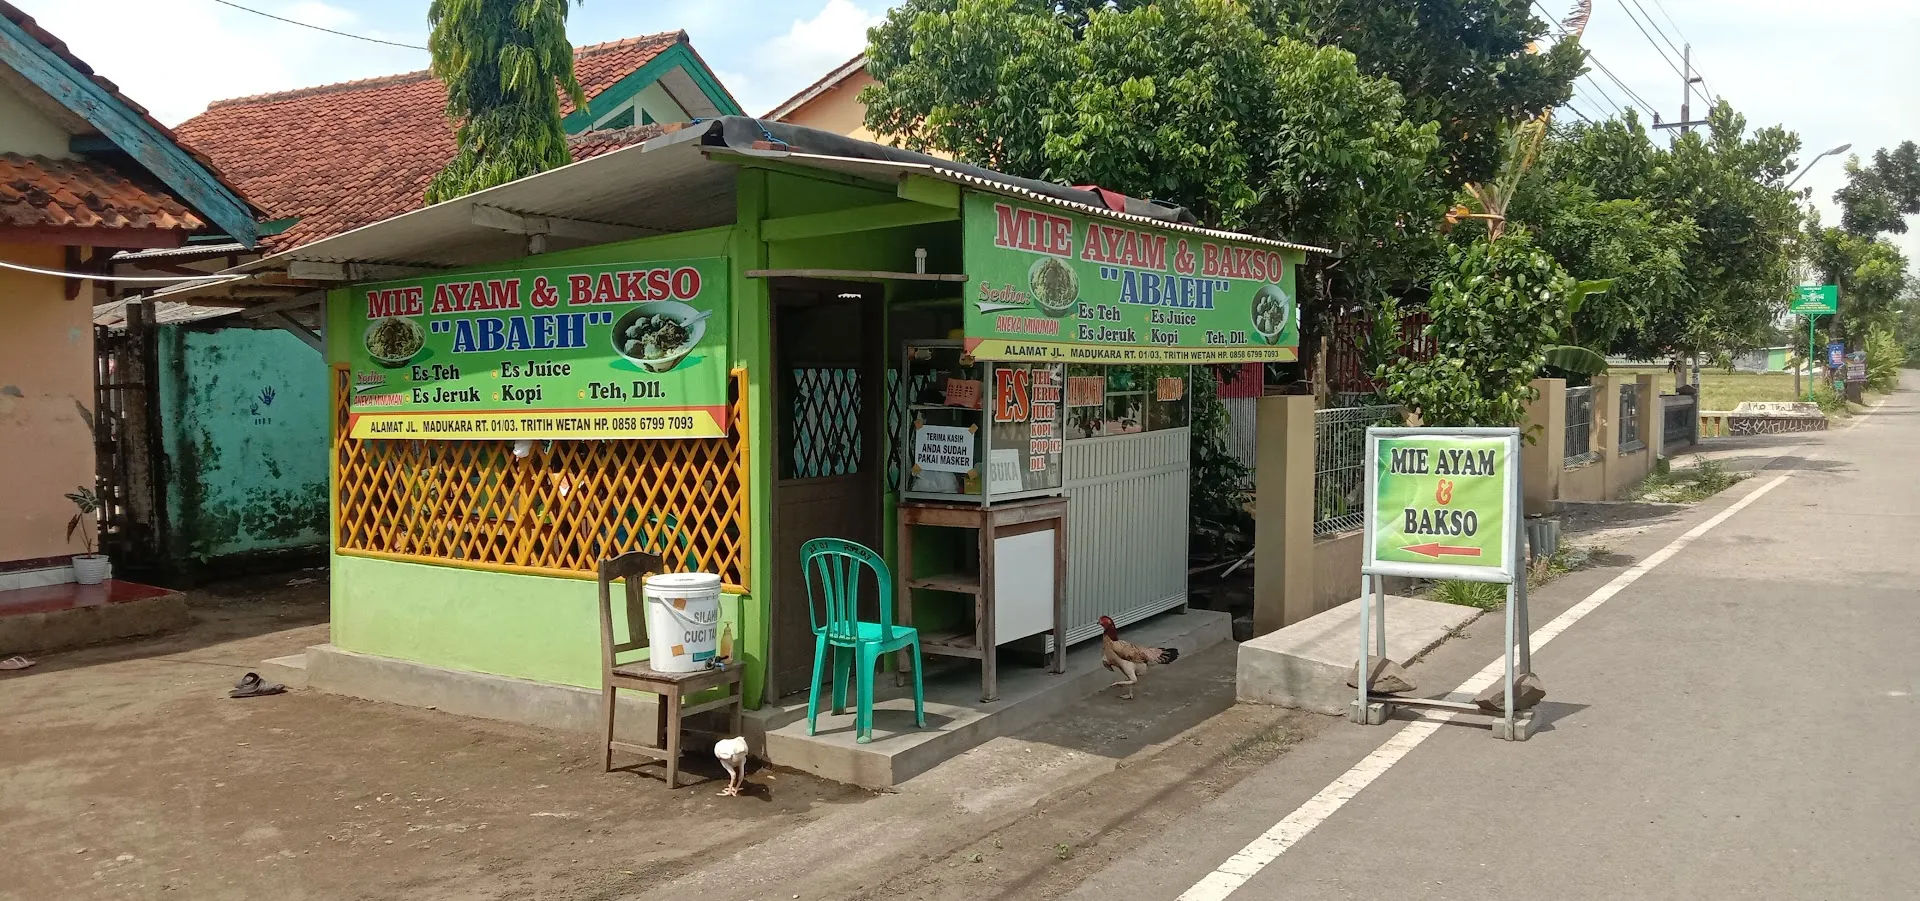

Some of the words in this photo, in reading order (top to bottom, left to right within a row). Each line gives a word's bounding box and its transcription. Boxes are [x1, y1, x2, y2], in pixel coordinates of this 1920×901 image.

[995, 203, 1072, 258] MIE
[1081, 223, 1167, 271] AYAM
[1174, 240, 1194, 275] &
[1201, 242, 1283, 284] BAKSO
[367, 287, 423, 319] MIE
[431, 276, 520, 314] AYAM
[533, 277, 558, 309] &
[568, 268, 701, 305] BAKSO
[980, 281, 1031, 305] Sedia:
[1100, 267, 1230, 310] "ABAEH"
[1078, 303, 1094, 319] Es
[1097, 305, 1121, 321] Teh
[1151, 309, 1165, 324] Es
[1167, 310, 1196, 325] Juice
[431, 312, 614, 354] "ABAEH"
[995, 315, 1022, 333] ANEKA
[1023, 317, 1059, 336] MINUMAN
[1078, 325, 1094, 340] Es
[1097, 326, 1136, 342] Jeruk
[1151, 328, 1178, 346] Kopi
[1205, 331, 1228, 347] Teh,
[1230, 331, 1248, 344] Dll.
[1004, 345, 1047, 357] ALAMAT
[1050, 347, 1065, 357] JL.
[1070, 348, 1121, 359] MADUKARA
[1124, 350, 1136, 359] RT.
[1164, 351, 1189, 360] TRITIH
[1191, 351, 1216, 360] WETAN
[1217, 351, 1228, 359] HP.
[1229, 351, 1245, 359] 0858
[1247, 350, 1263, 358] 6799
[1264, 350, 1279, 358] 7093
[412, 365, 429, 381] Es
[431, 364, 460, 380] Teh
[501, 361, 520, 378] Es
[524, 360, 571, 377] Juice
[1032, 369, 1051, 385] TEH
[412, 388, 429, 403] Es
[433, 386, 480, 404] Jeruk
[501, 384, 542, 404] Kopi
[588, 383, 627, 401] Teh,
[632, 381, 666, 399] Dll.
[995, 368, 1029, 422] ES
[1031, 386, 1061, 402] JERUK
[1031, 403, 1056, 422] JUICE
[370, 421, 403, 433] ALAMAT
[405, 421, 418, 433] JL.
[423, 420, 473, 432] MADUKARA
[475, 419, 489, 432] RT.
[491, 419, 518, 432] 01/03.
[520, 418, 553, 431] TRITIH
[555, 418, 590, 431] WETAN
[594, 418, 609, 430] HP.
[612, 417, 637, 430] 0858
[640, 417, 665, 430] 6799
[668, 416, 693, 430] 7093
[1030, 422, 1052, 438] KOPI
[926, 432, 946, 442] TERIMA
[947, 434, 964, 443] KASIH
[1030, 439, 1048, 454] POP
[1049, 439, 1062, 454] ICE
[922, 443, 941, 453] ANDA
[943, 445, 967, 456] SUDAH
[918, 453, 938, 464] PAKAI
[940, 455, 970, 467] MASKER
[1390, 448, 1429, 474] MIE
[1434, 449, 1496, 476] AYAM
[990, 461, 1019, 482] BUKA
[1435, 478, 1453, 505] &
[1404, 508, 1478, 537] BAKSO
[684, 630, 707, 644] CUCI
